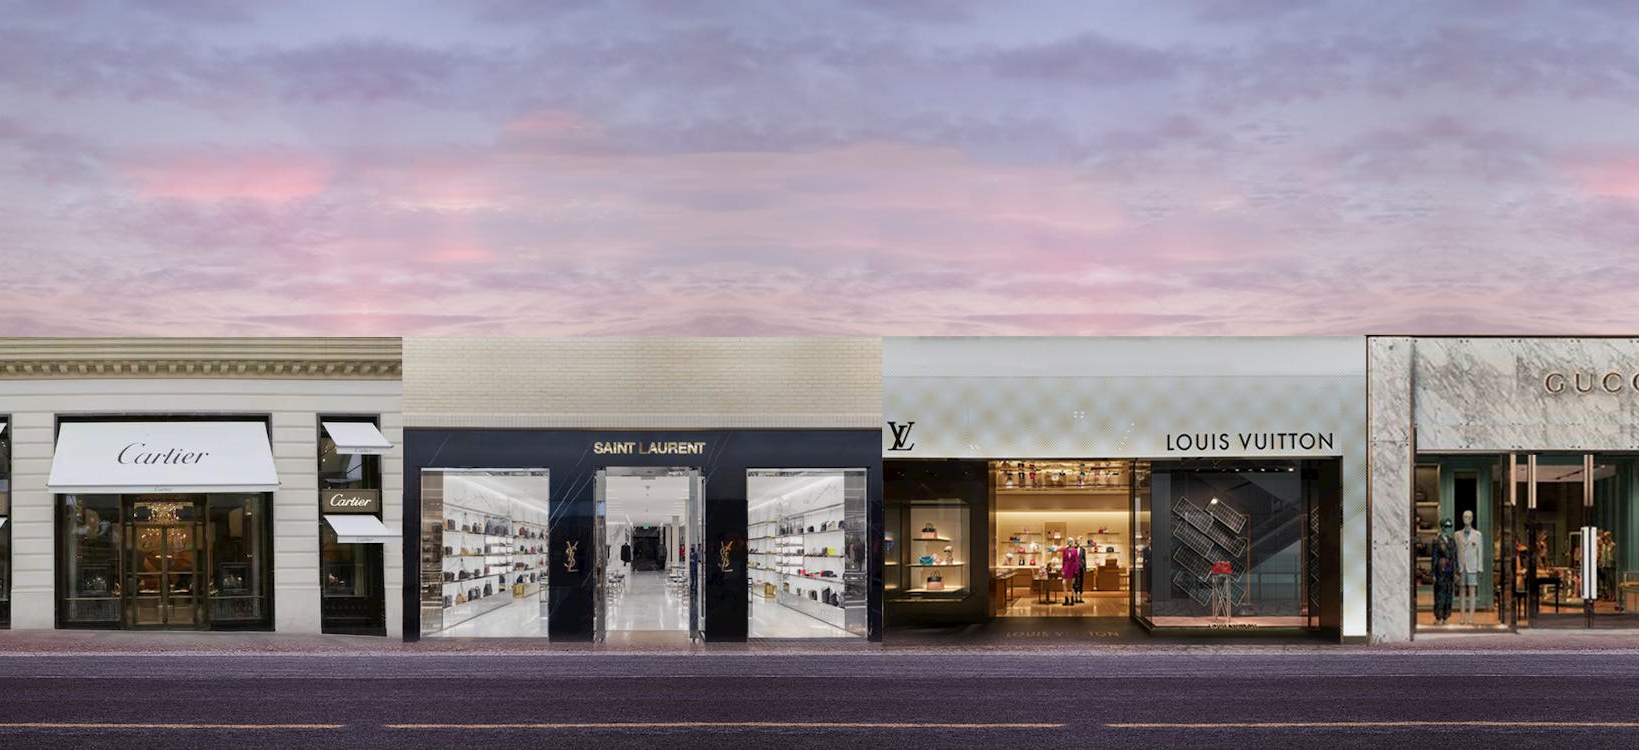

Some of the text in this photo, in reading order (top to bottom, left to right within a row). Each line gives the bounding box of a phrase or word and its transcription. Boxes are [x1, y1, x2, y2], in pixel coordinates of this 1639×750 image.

[593, 442, 706, 454] SAINT LAURENT
[1167, 433, 1333, 451] LOUIS VUITTON
[118, 442, 209, 464] Cartier
[330, 493, 372, 507] Cartier
